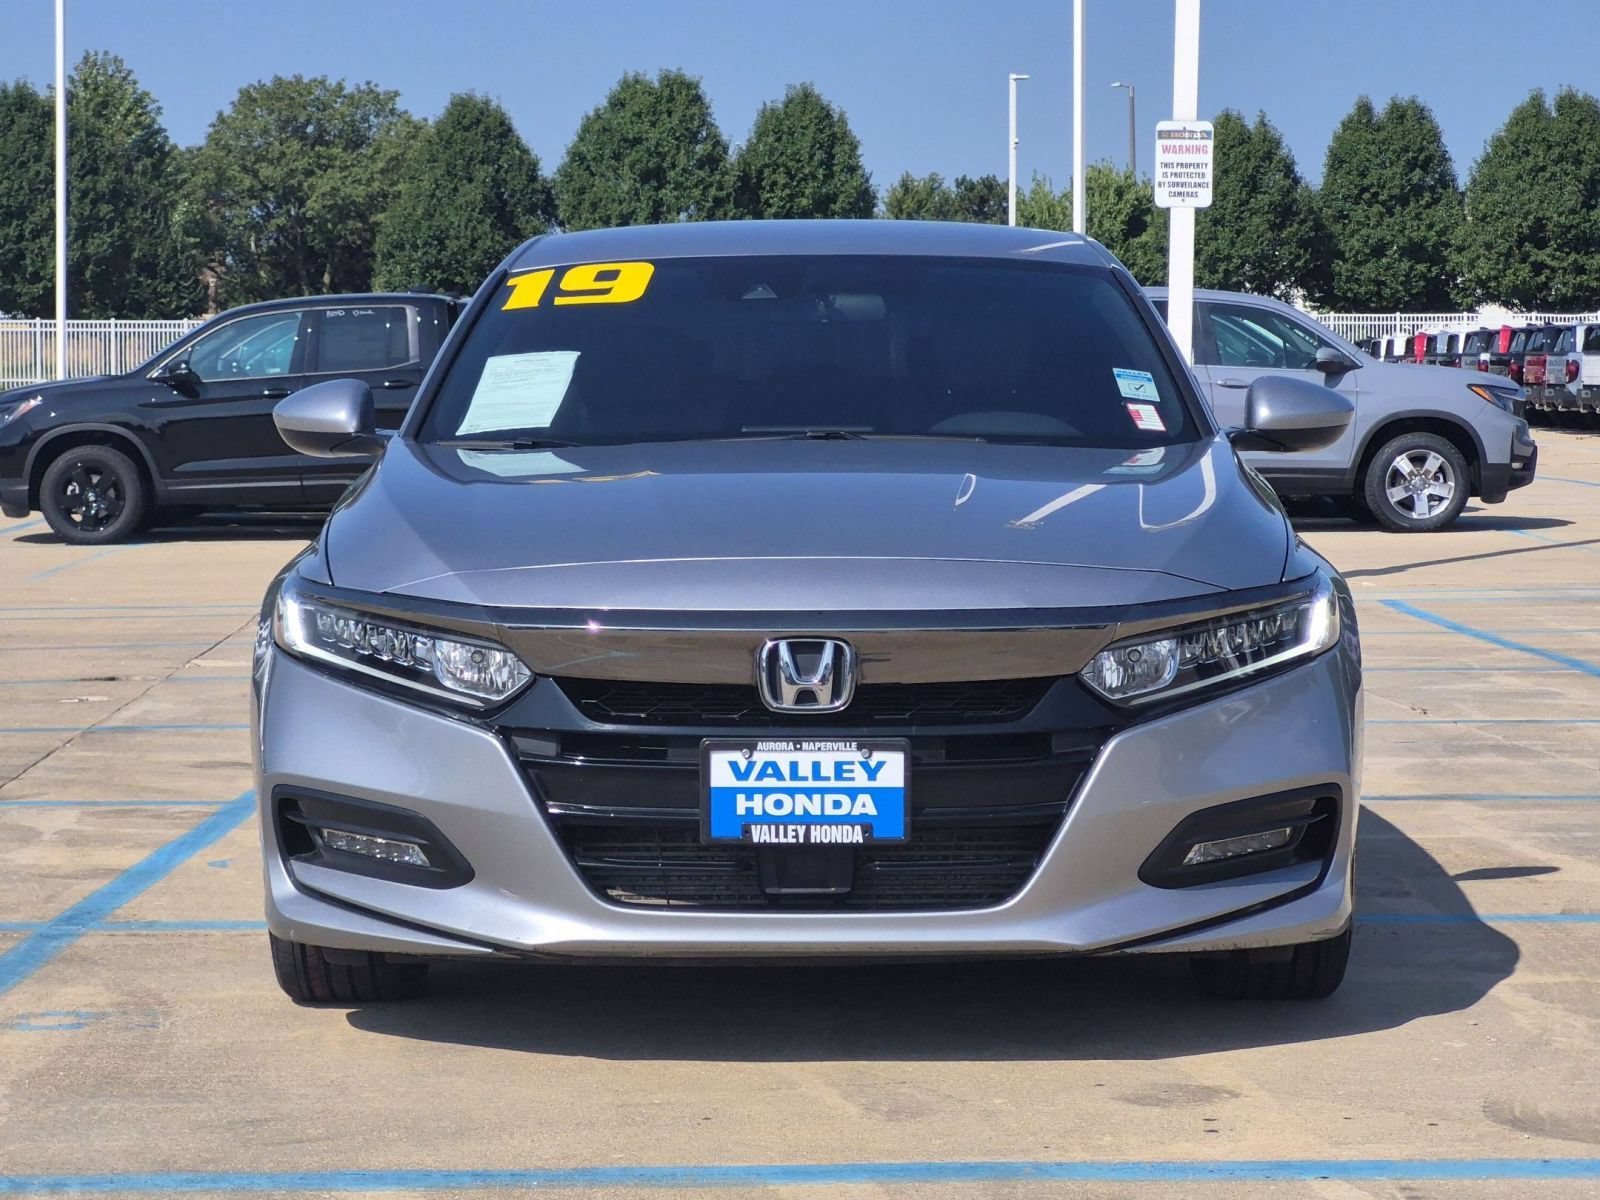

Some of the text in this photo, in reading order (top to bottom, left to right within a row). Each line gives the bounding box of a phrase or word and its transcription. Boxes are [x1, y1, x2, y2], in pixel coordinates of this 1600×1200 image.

[1161, 144, 1209, 155] WARNING
[501, 262, 655, 310] 19
[756, 742, 858, 751] AURORA NAPERVILLE
[727, 760, 887, 782] VALLEY
[736, 793, 878, 816] HONDA
[751, 825, 864, 844] VALLEY HONDA
